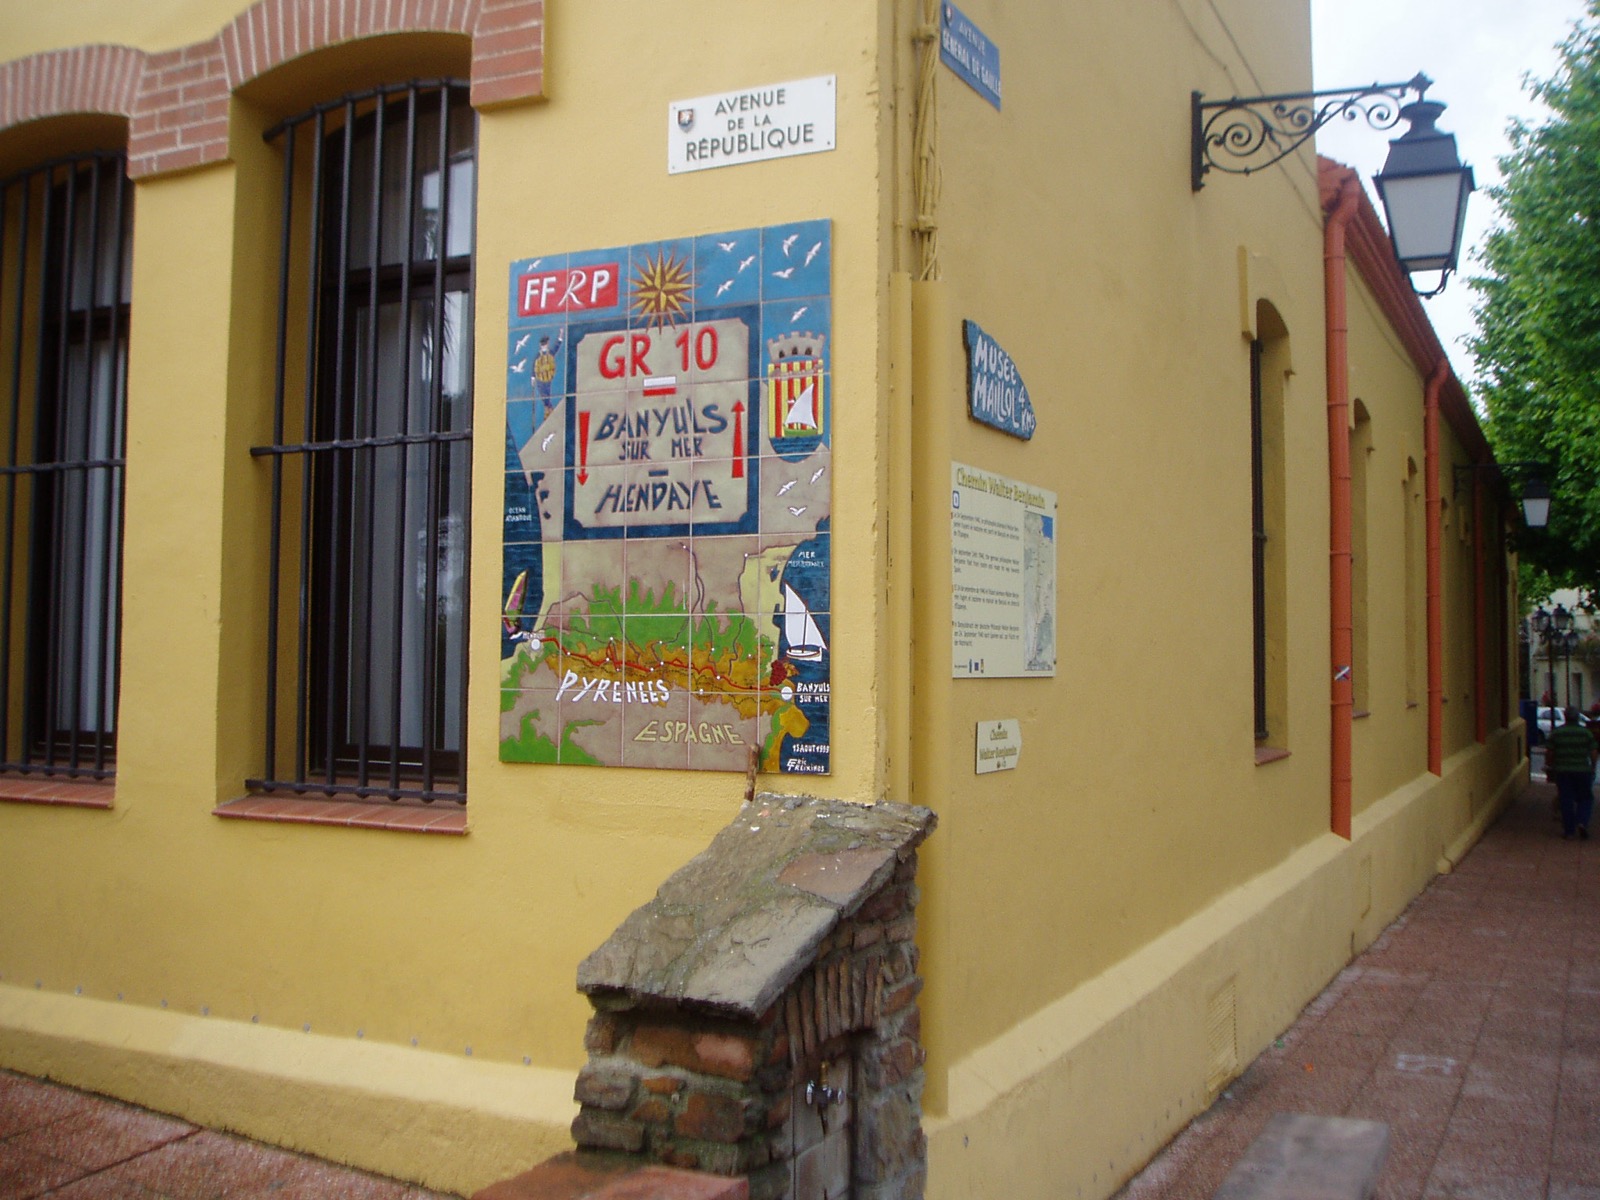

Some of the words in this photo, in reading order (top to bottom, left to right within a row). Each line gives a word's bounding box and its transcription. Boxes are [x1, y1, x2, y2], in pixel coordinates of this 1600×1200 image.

[714, 88, 786, 116] AVENUE
[727, 117, 744, 132] DE
[754, 114, 772, 127] LA
[686, 123, 814, 161] RÉPUBLIQUE
[524, 269, 610, 311] FFRP
[598, 333, 653, 380] GR
[675, 326, 719, 372] 10
[974, 371, 1020, 429] MAILLOL
[1018, 386, 1026, 409] 4
[594, 398, 728, 441] BANYULS
[618, 440, 652, 461] SUR
[671, 436, 703, 458] MER
[594, 480, 722, 514] HENDAYE
[798, 551, 816, 559] MER
[555, 669, 670, 704] PYRENEES
[796, 681, 830, 693] BANYULS
[799, 694, 812, 703] SUR
[814, 694, 829, 703] MER
[634, 720, 746, 745] ESPAGNE
